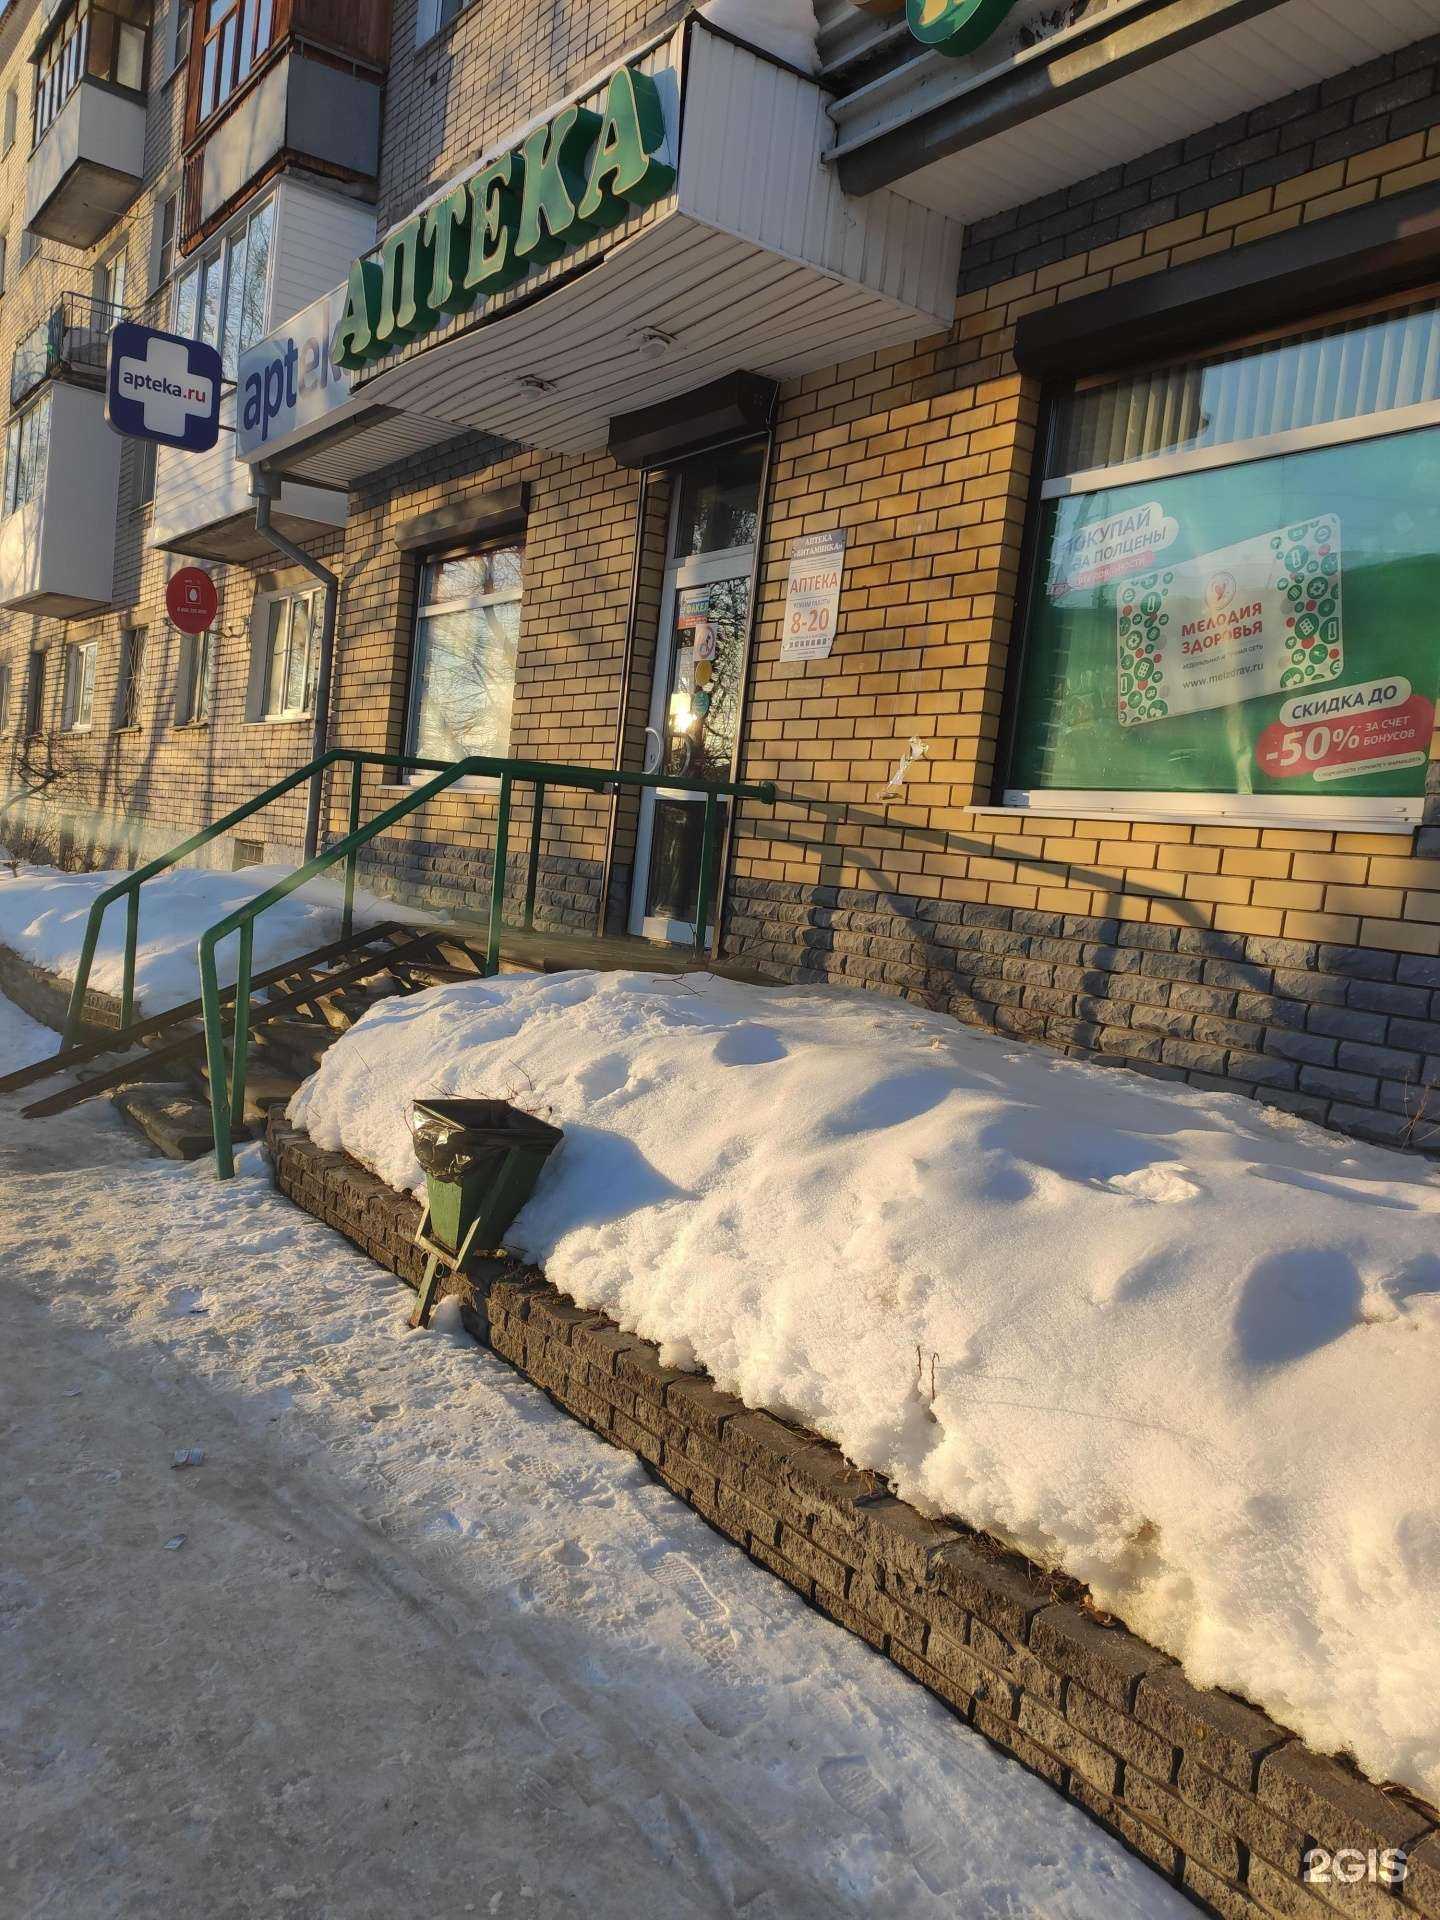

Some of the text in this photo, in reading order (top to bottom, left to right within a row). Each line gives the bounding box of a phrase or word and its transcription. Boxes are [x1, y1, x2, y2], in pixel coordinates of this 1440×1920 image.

[329, 65, 655, 366] АПТЕКА
[123, 371, 206, 403] apteka.ru
[805, 534, 833, 546] АПТЕКА
[1094, 527, 1167, 564] ПОЛЦЕНЫ
[790, 572, 838, 594] АПТЕКА
[791, 607, 830, 634] 8-20
[1181, 602, 1263, 637] МЕЛОДИЯ
[1182, 663, 1264, 689] www.melzdrav.ru
[1291, 685, 1398, 719] СКИДКА ДО
[1363, 729, 1416, 746] БОНУСОВ
[1365, 716, 1411, 732] ЗА СЧЕТ
[1266, 726, 1360, 767] -50%
